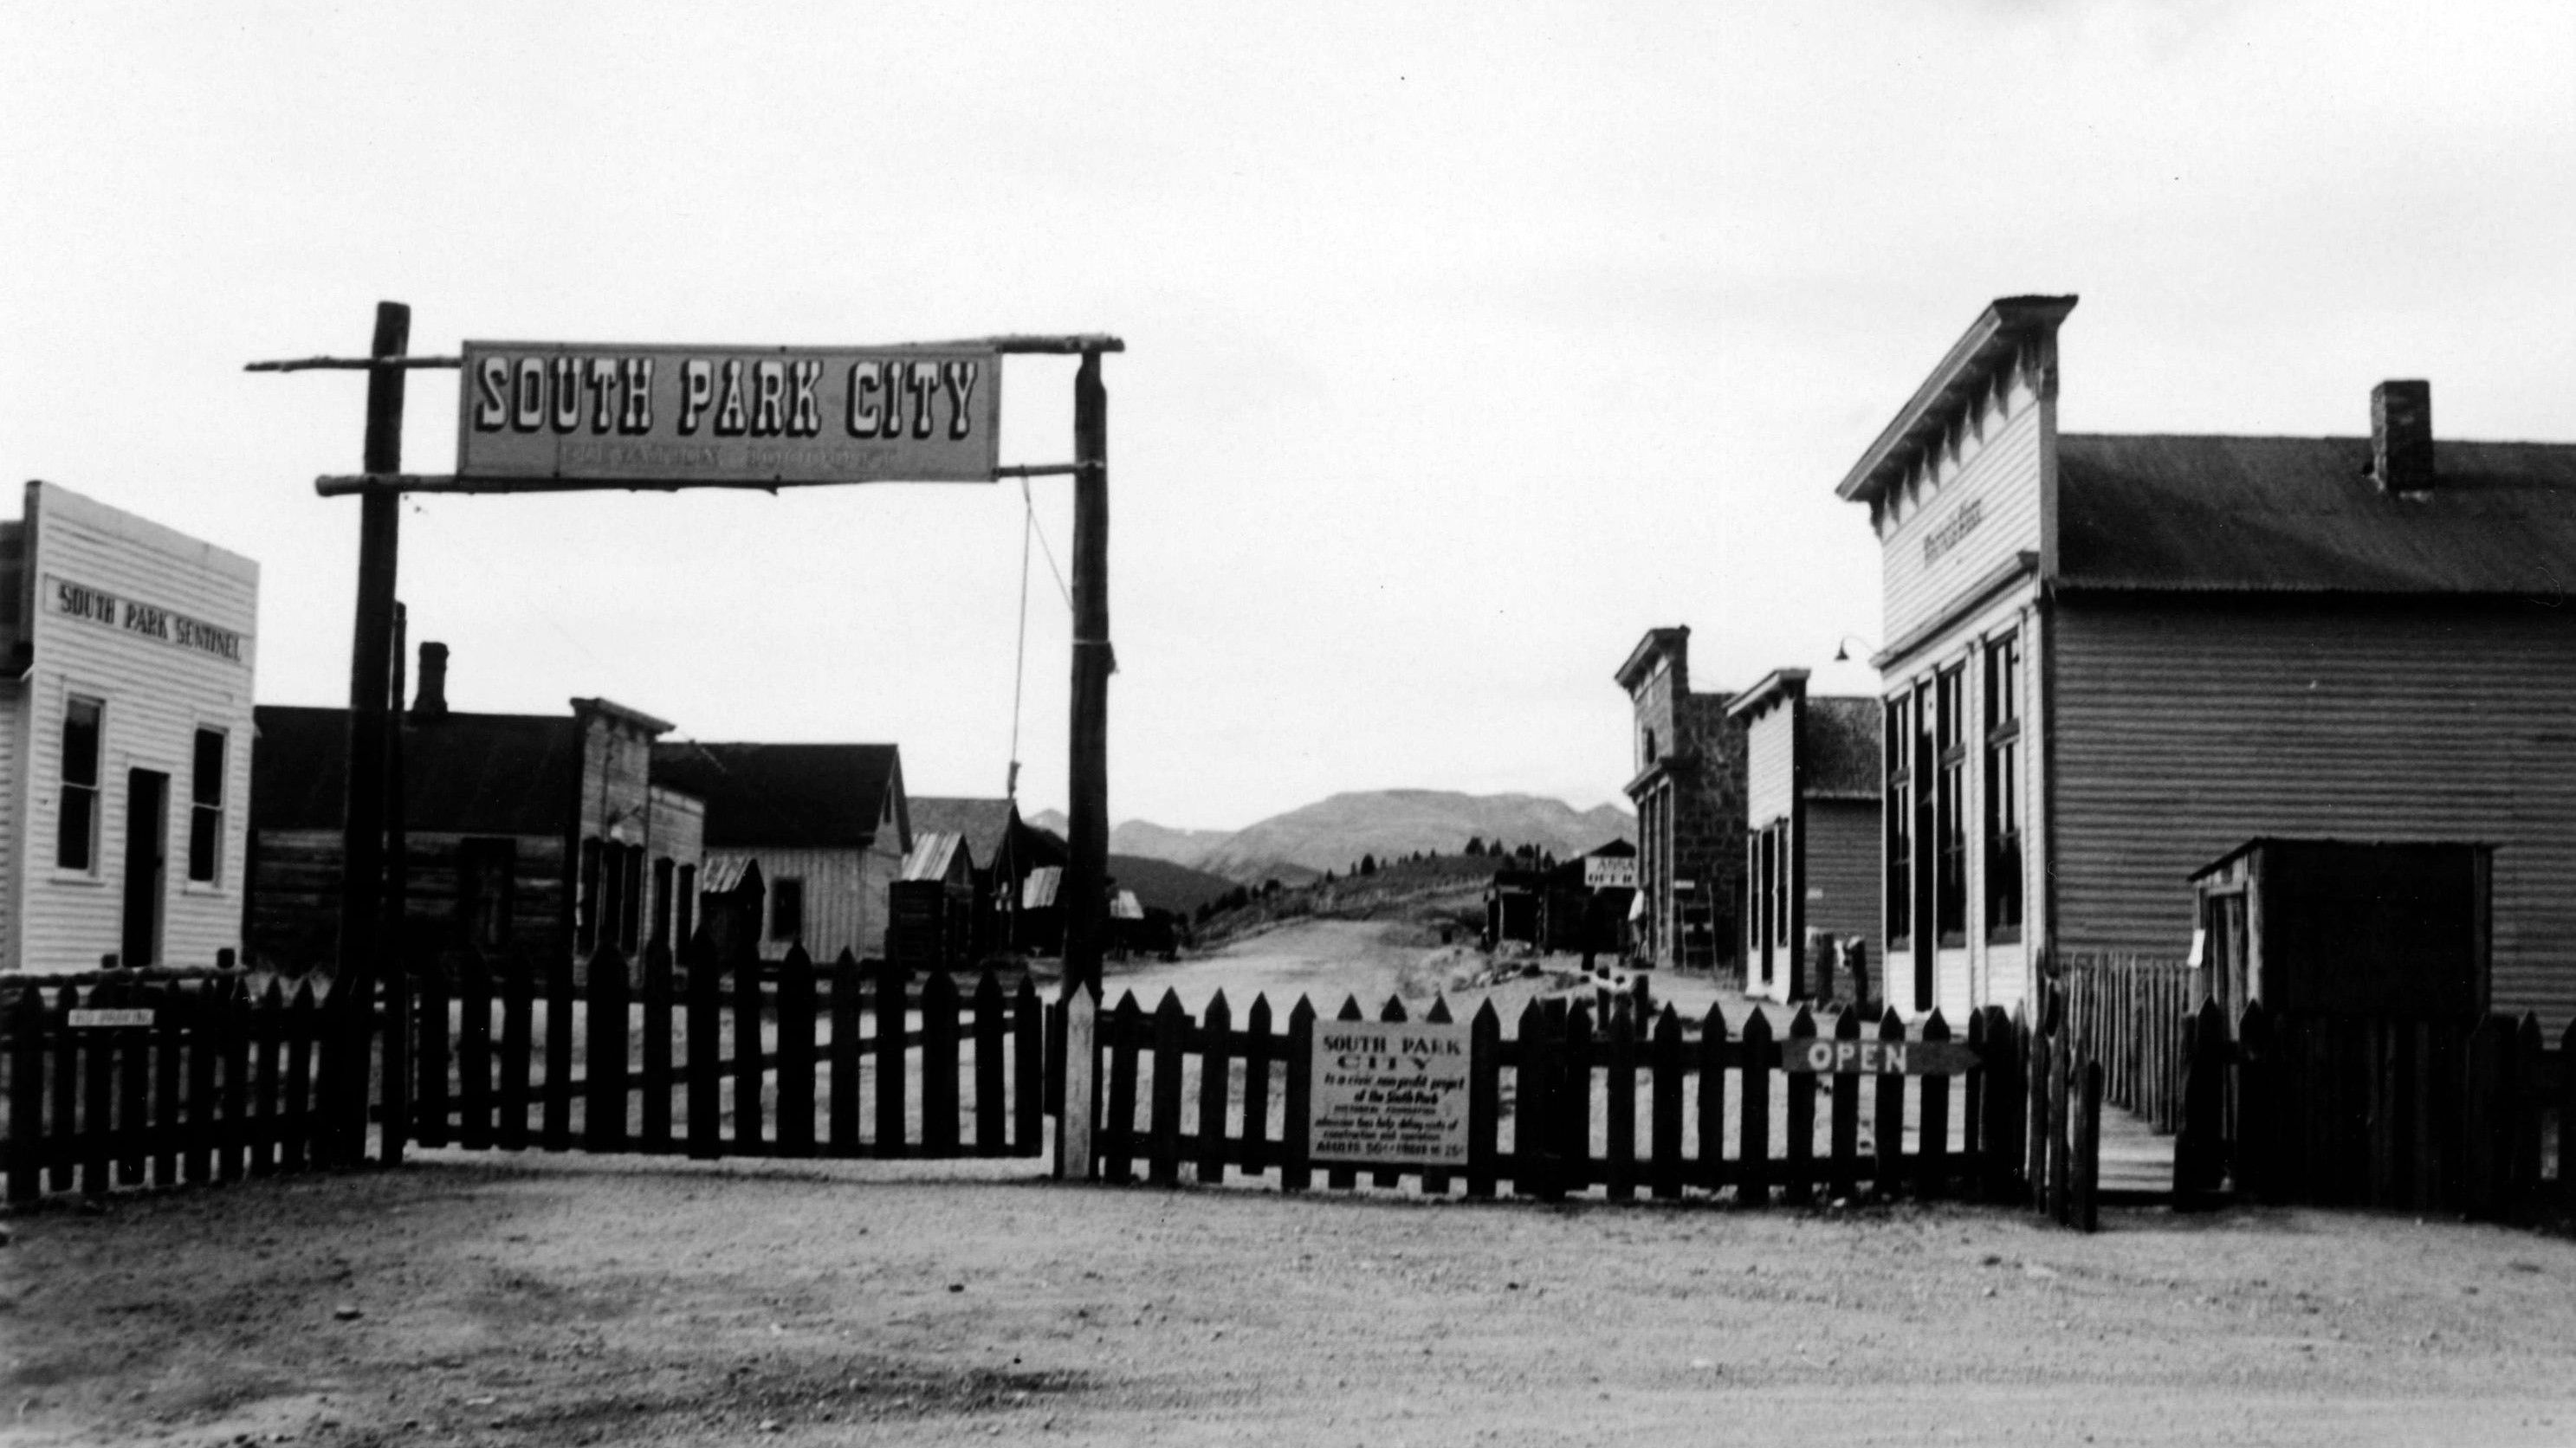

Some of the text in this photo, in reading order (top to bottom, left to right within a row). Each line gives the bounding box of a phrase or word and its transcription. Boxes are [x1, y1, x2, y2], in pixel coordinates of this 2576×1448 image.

[476, 356, 978, 441] SOUTH PARK CITY
[57, 583, 242, 663] SOUTH PARK SENTINEL
[1324, 1035, 1461, 1056] SOUTH PARK
[1337, 1054, 1432, 1070] CITY
[1807, 1042, 1906, 1073] OPEN
[1354, 1089, 1439, 1105] of the South Park
[1447, 1119, 1460, 1132] of
